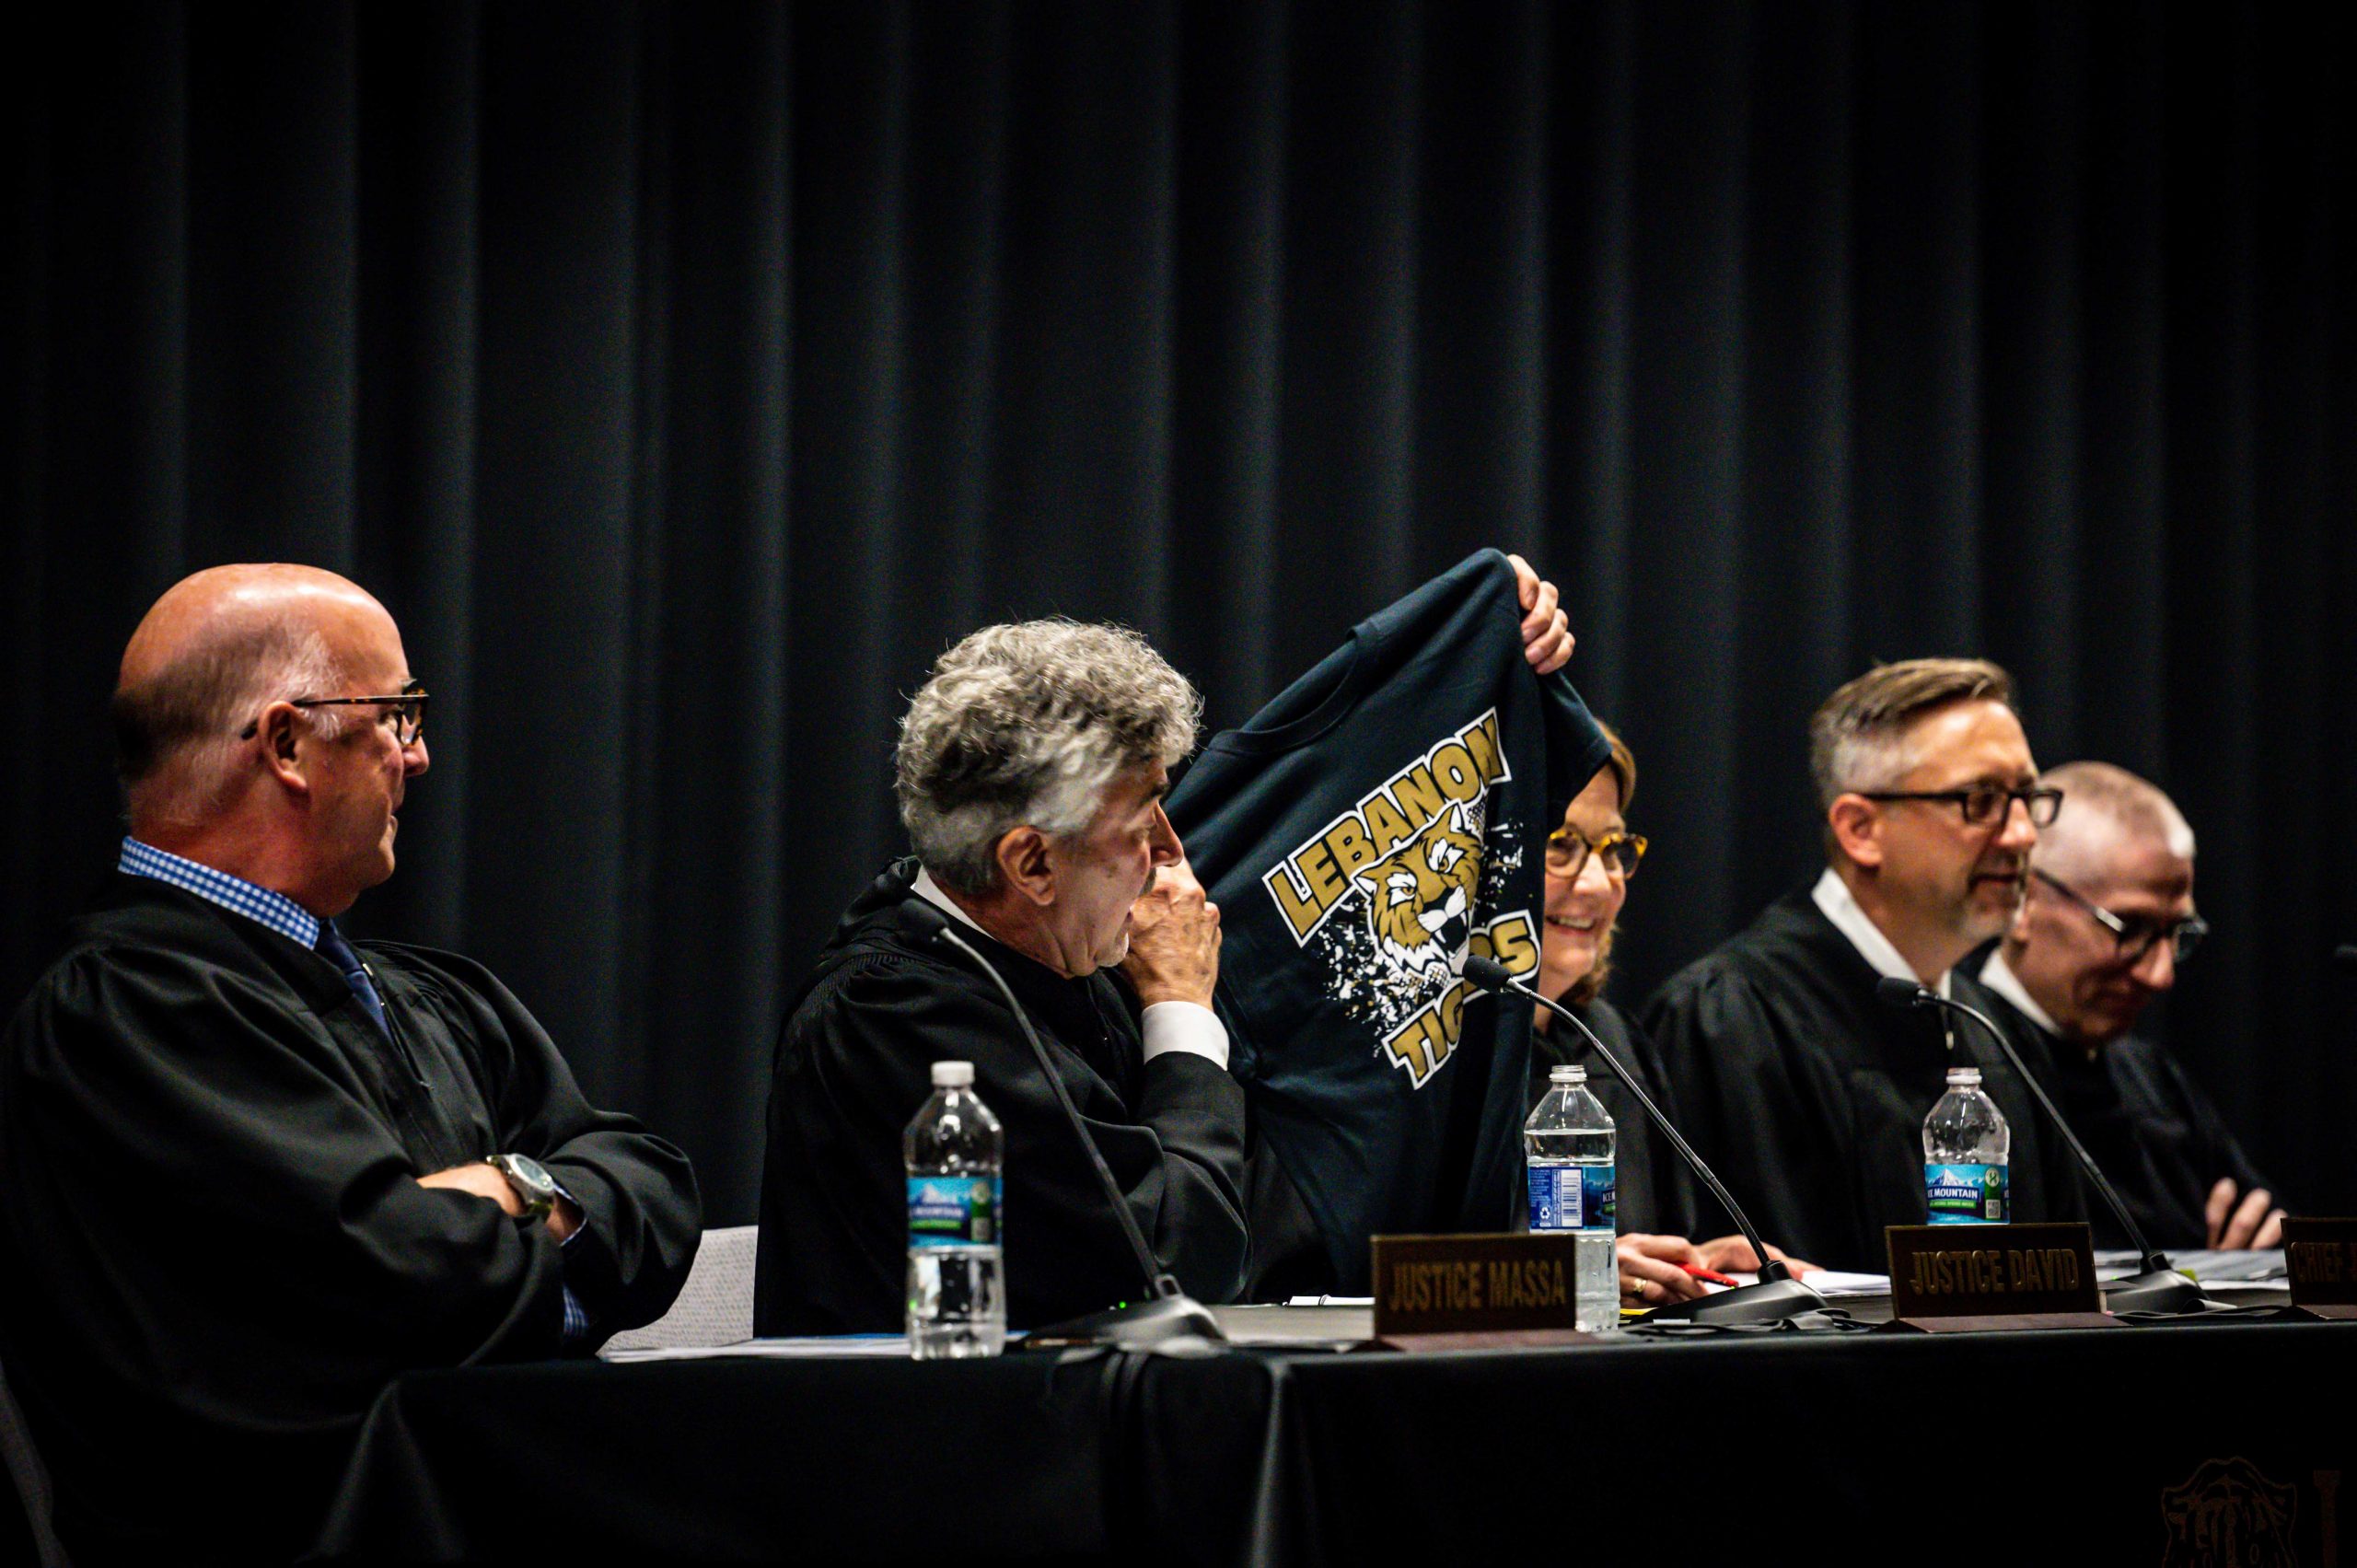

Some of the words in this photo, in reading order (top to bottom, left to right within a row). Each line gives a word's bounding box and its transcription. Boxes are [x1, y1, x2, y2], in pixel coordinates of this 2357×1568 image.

[1263, 708, 1510, 947] LEBANON
[1933, 1188, 1979, 1199] MOUNTAIN
[1388, 1260, 1482, 1311] JUSTICE
[1488, 1259, 1566, 1309] MASSA
[1909, 1249, 2005, 1295] JUSTICE
[2006, 1248, 2079, 1292] DAVID
[2290, 1241, 2343, 1283] CHIEF
